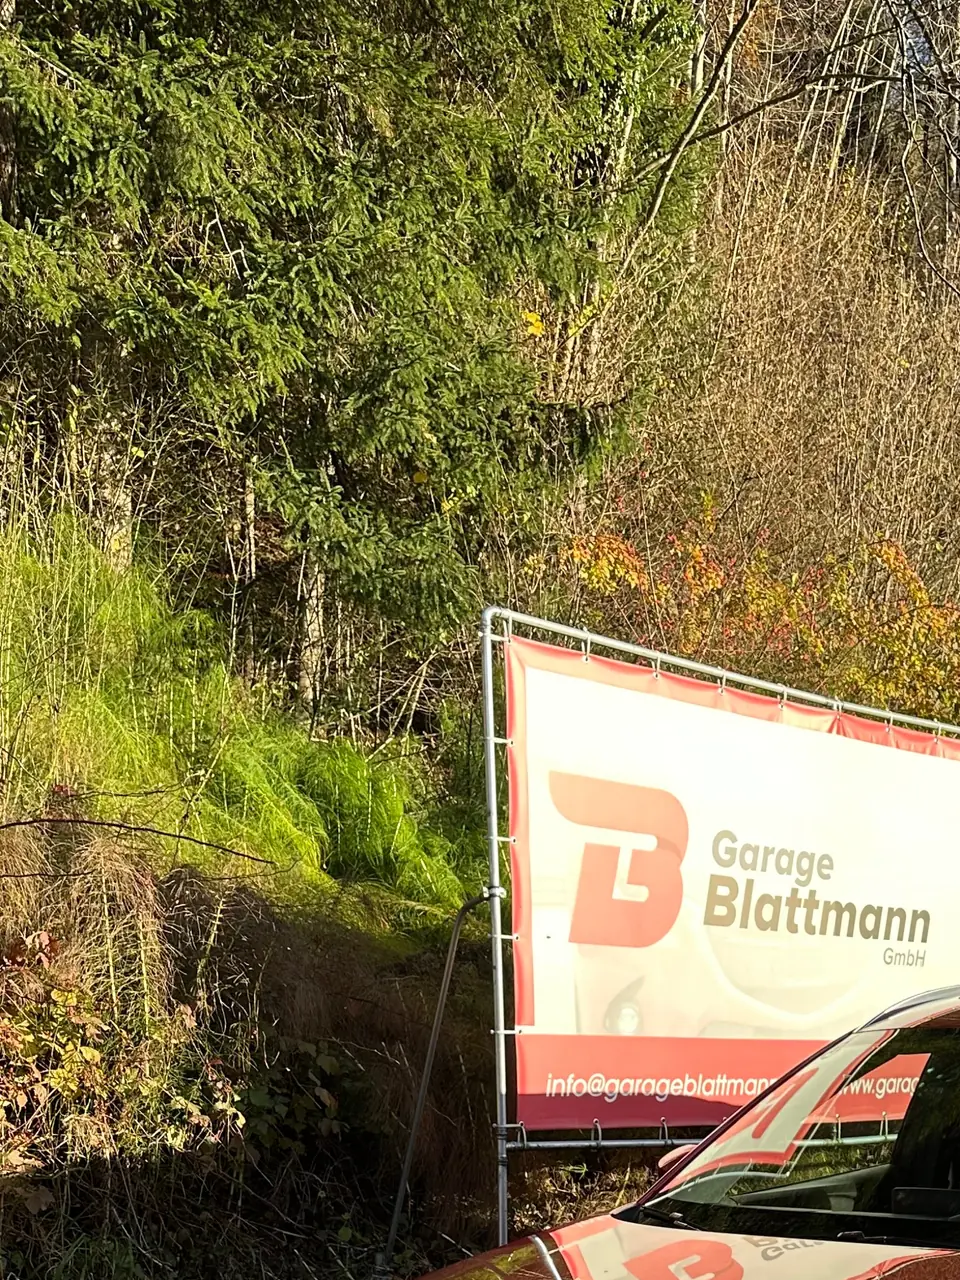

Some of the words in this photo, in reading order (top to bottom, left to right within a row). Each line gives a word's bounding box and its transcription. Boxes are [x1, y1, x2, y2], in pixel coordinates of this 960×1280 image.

[711, 829, 835, 887] Garage
[703, 873, 931, 943] Blattmann
[883, 946, 927, 968] GmbH
